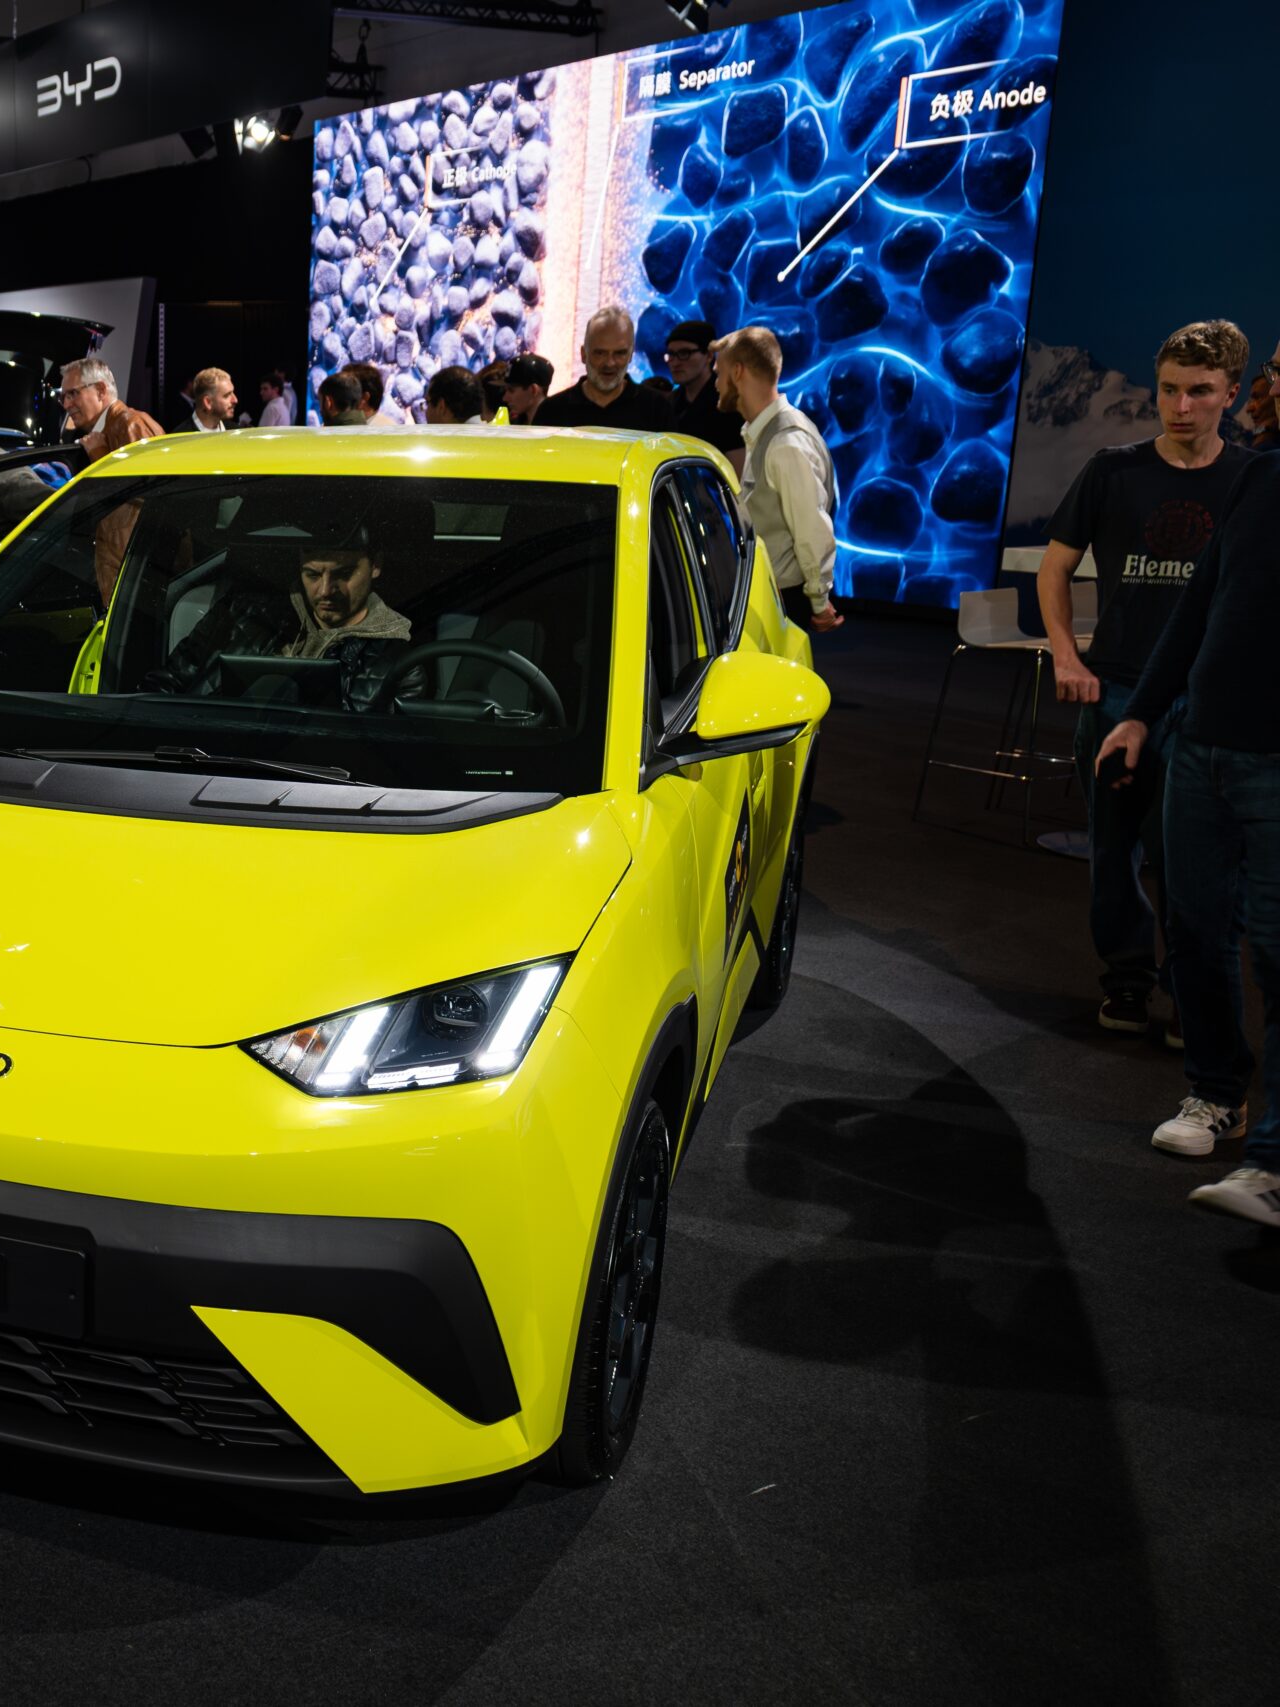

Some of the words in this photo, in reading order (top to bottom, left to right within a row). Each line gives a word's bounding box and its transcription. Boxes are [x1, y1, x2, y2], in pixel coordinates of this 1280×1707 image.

[36, 55, 122, 117] BYD
[678, 59, 756, 91] Separator
[929, 88, 974, 122] 负极
[978, 81, 1047, 112] Anode
[1122, 554, 1195, 579] Eleme
